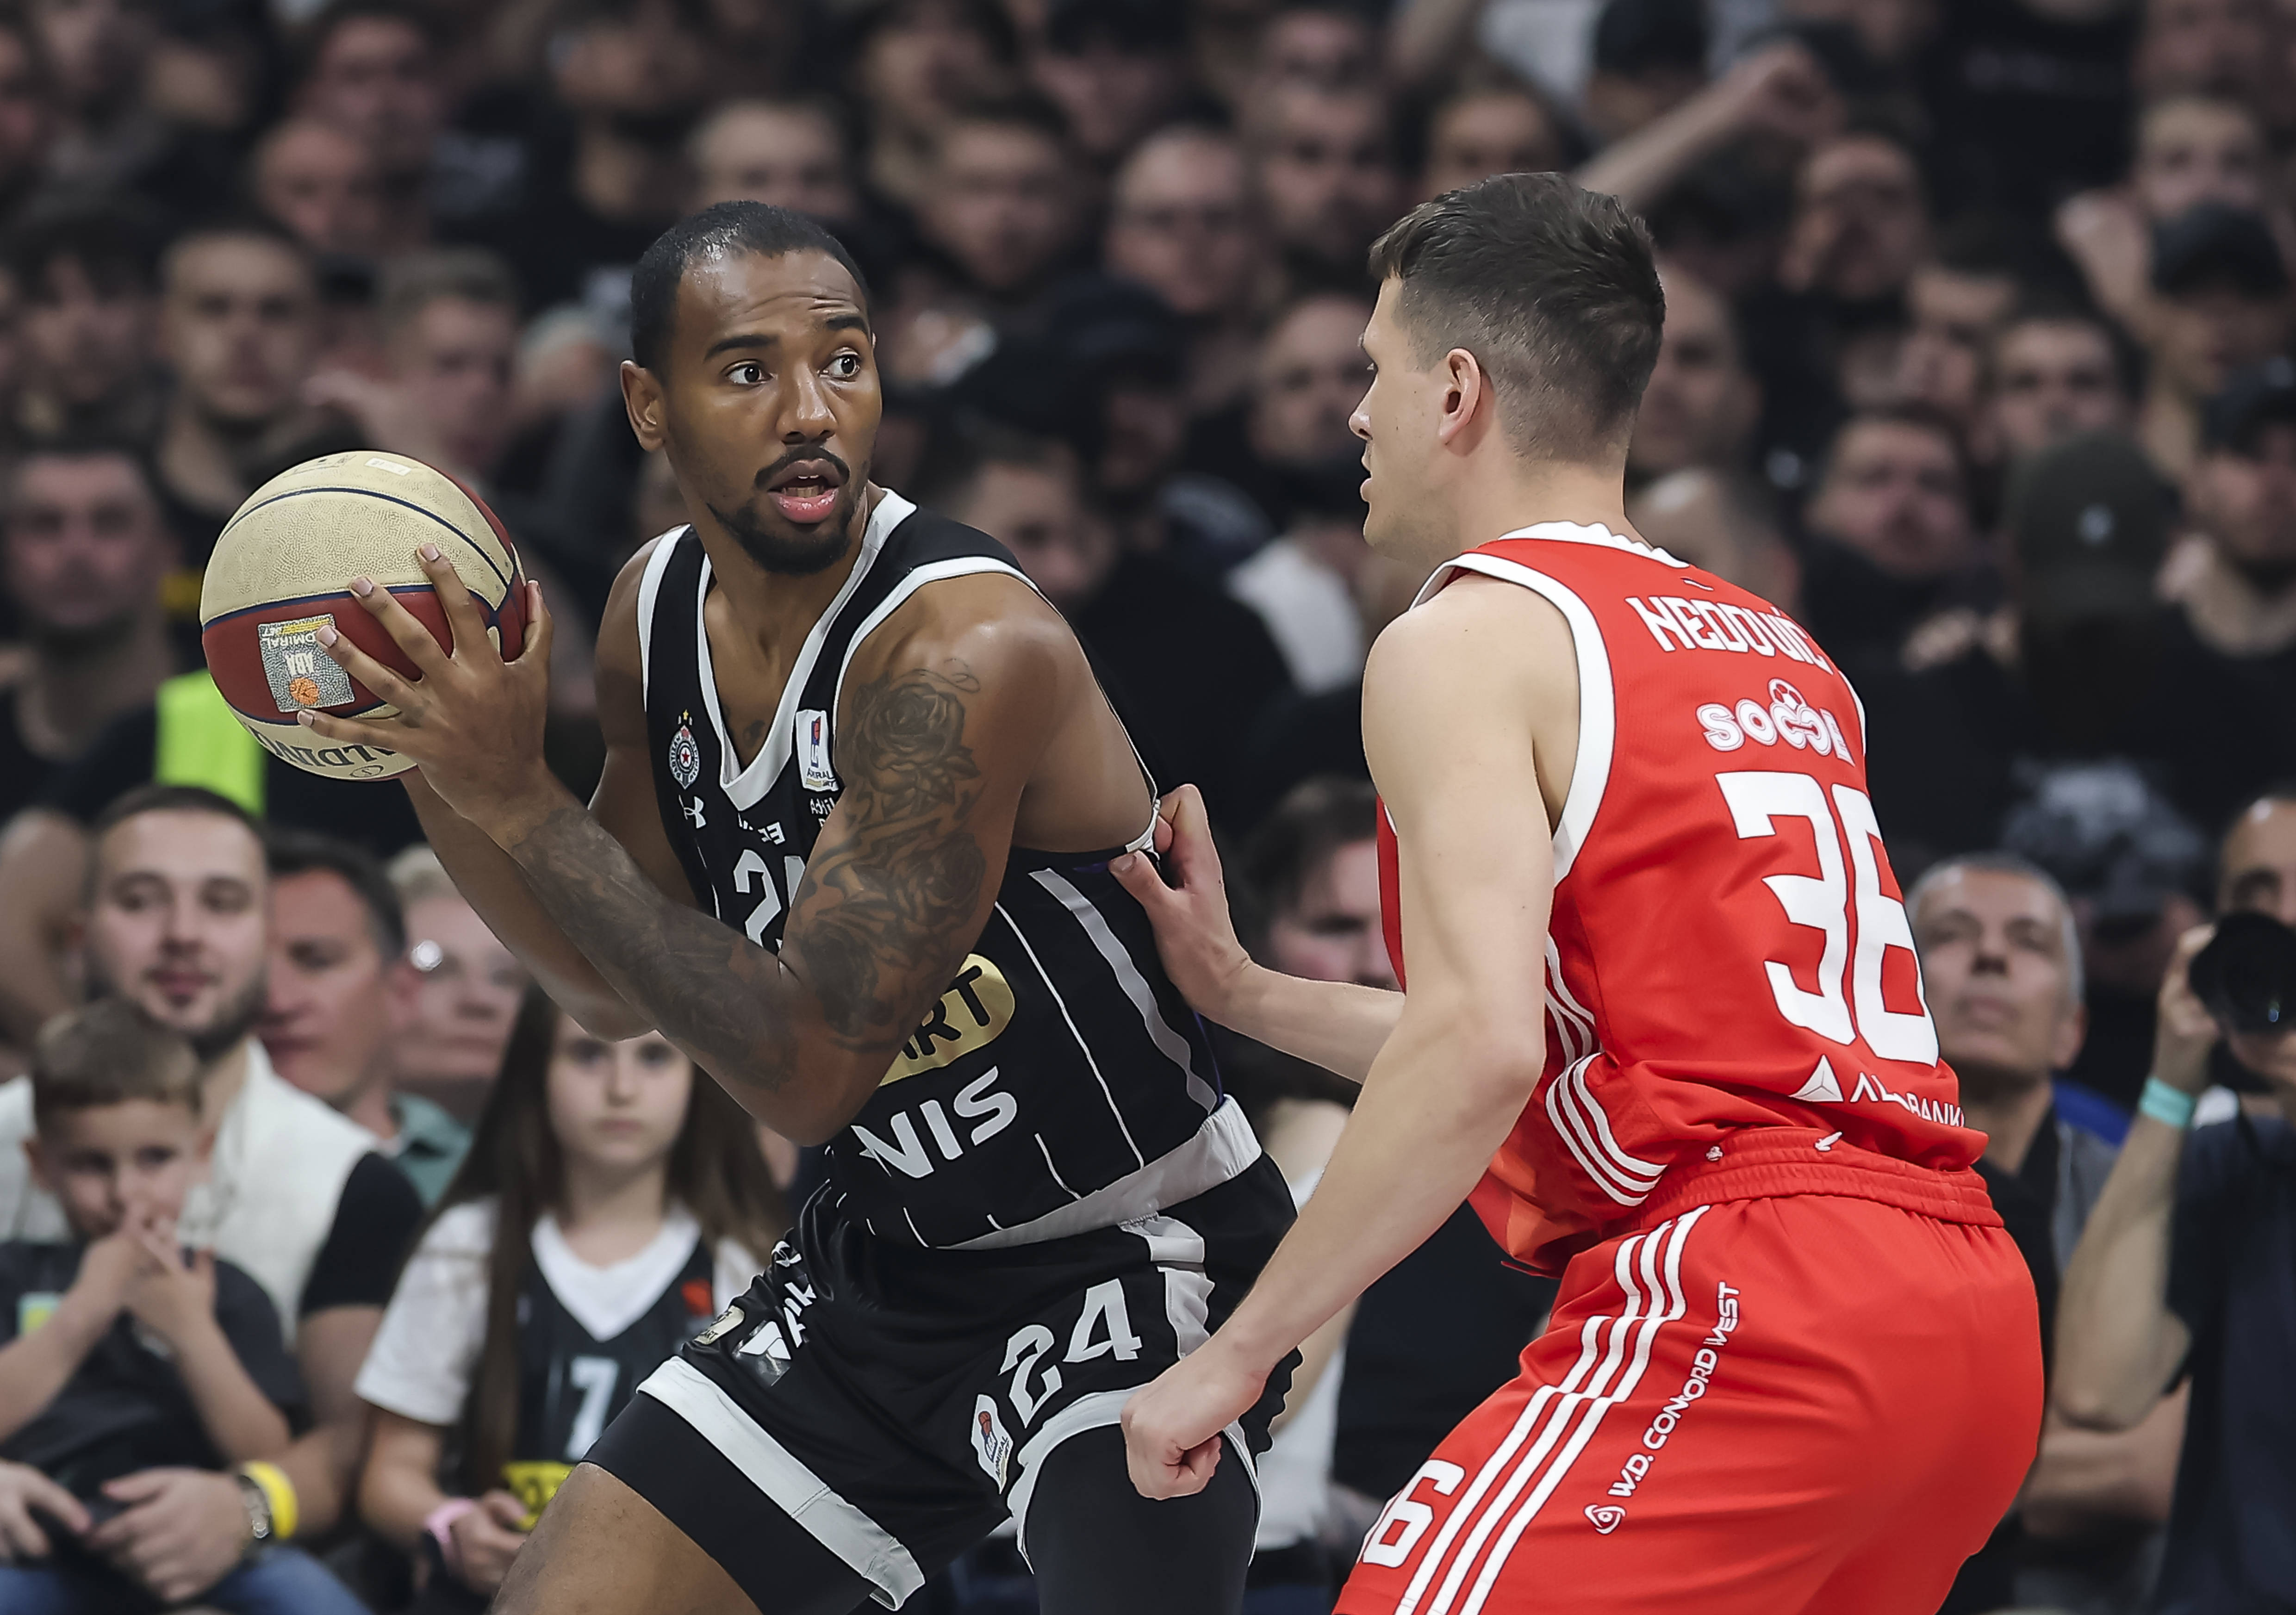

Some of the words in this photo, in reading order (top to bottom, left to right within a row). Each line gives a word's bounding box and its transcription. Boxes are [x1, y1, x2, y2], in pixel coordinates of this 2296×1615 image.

[261, 632, 317, 649] DMIRAL
[285, 651, 315, 677] ABA
[733, 849, 806, 949] 2
[1714, 770, 1940, 1068] 36
[850, 1065, 1017, 1179] NIS
[1906, 1093, 1965, 1128] BANK
[998, 1278, 1143, 1429] 24
[1607, 1454, 1655, 1497] W.D.
[1642, 1348, 1719, 1450] CONORD
[1703, 1281, 1741, 1346] WEST
[1356, 1459, 1466, 1569] 6
